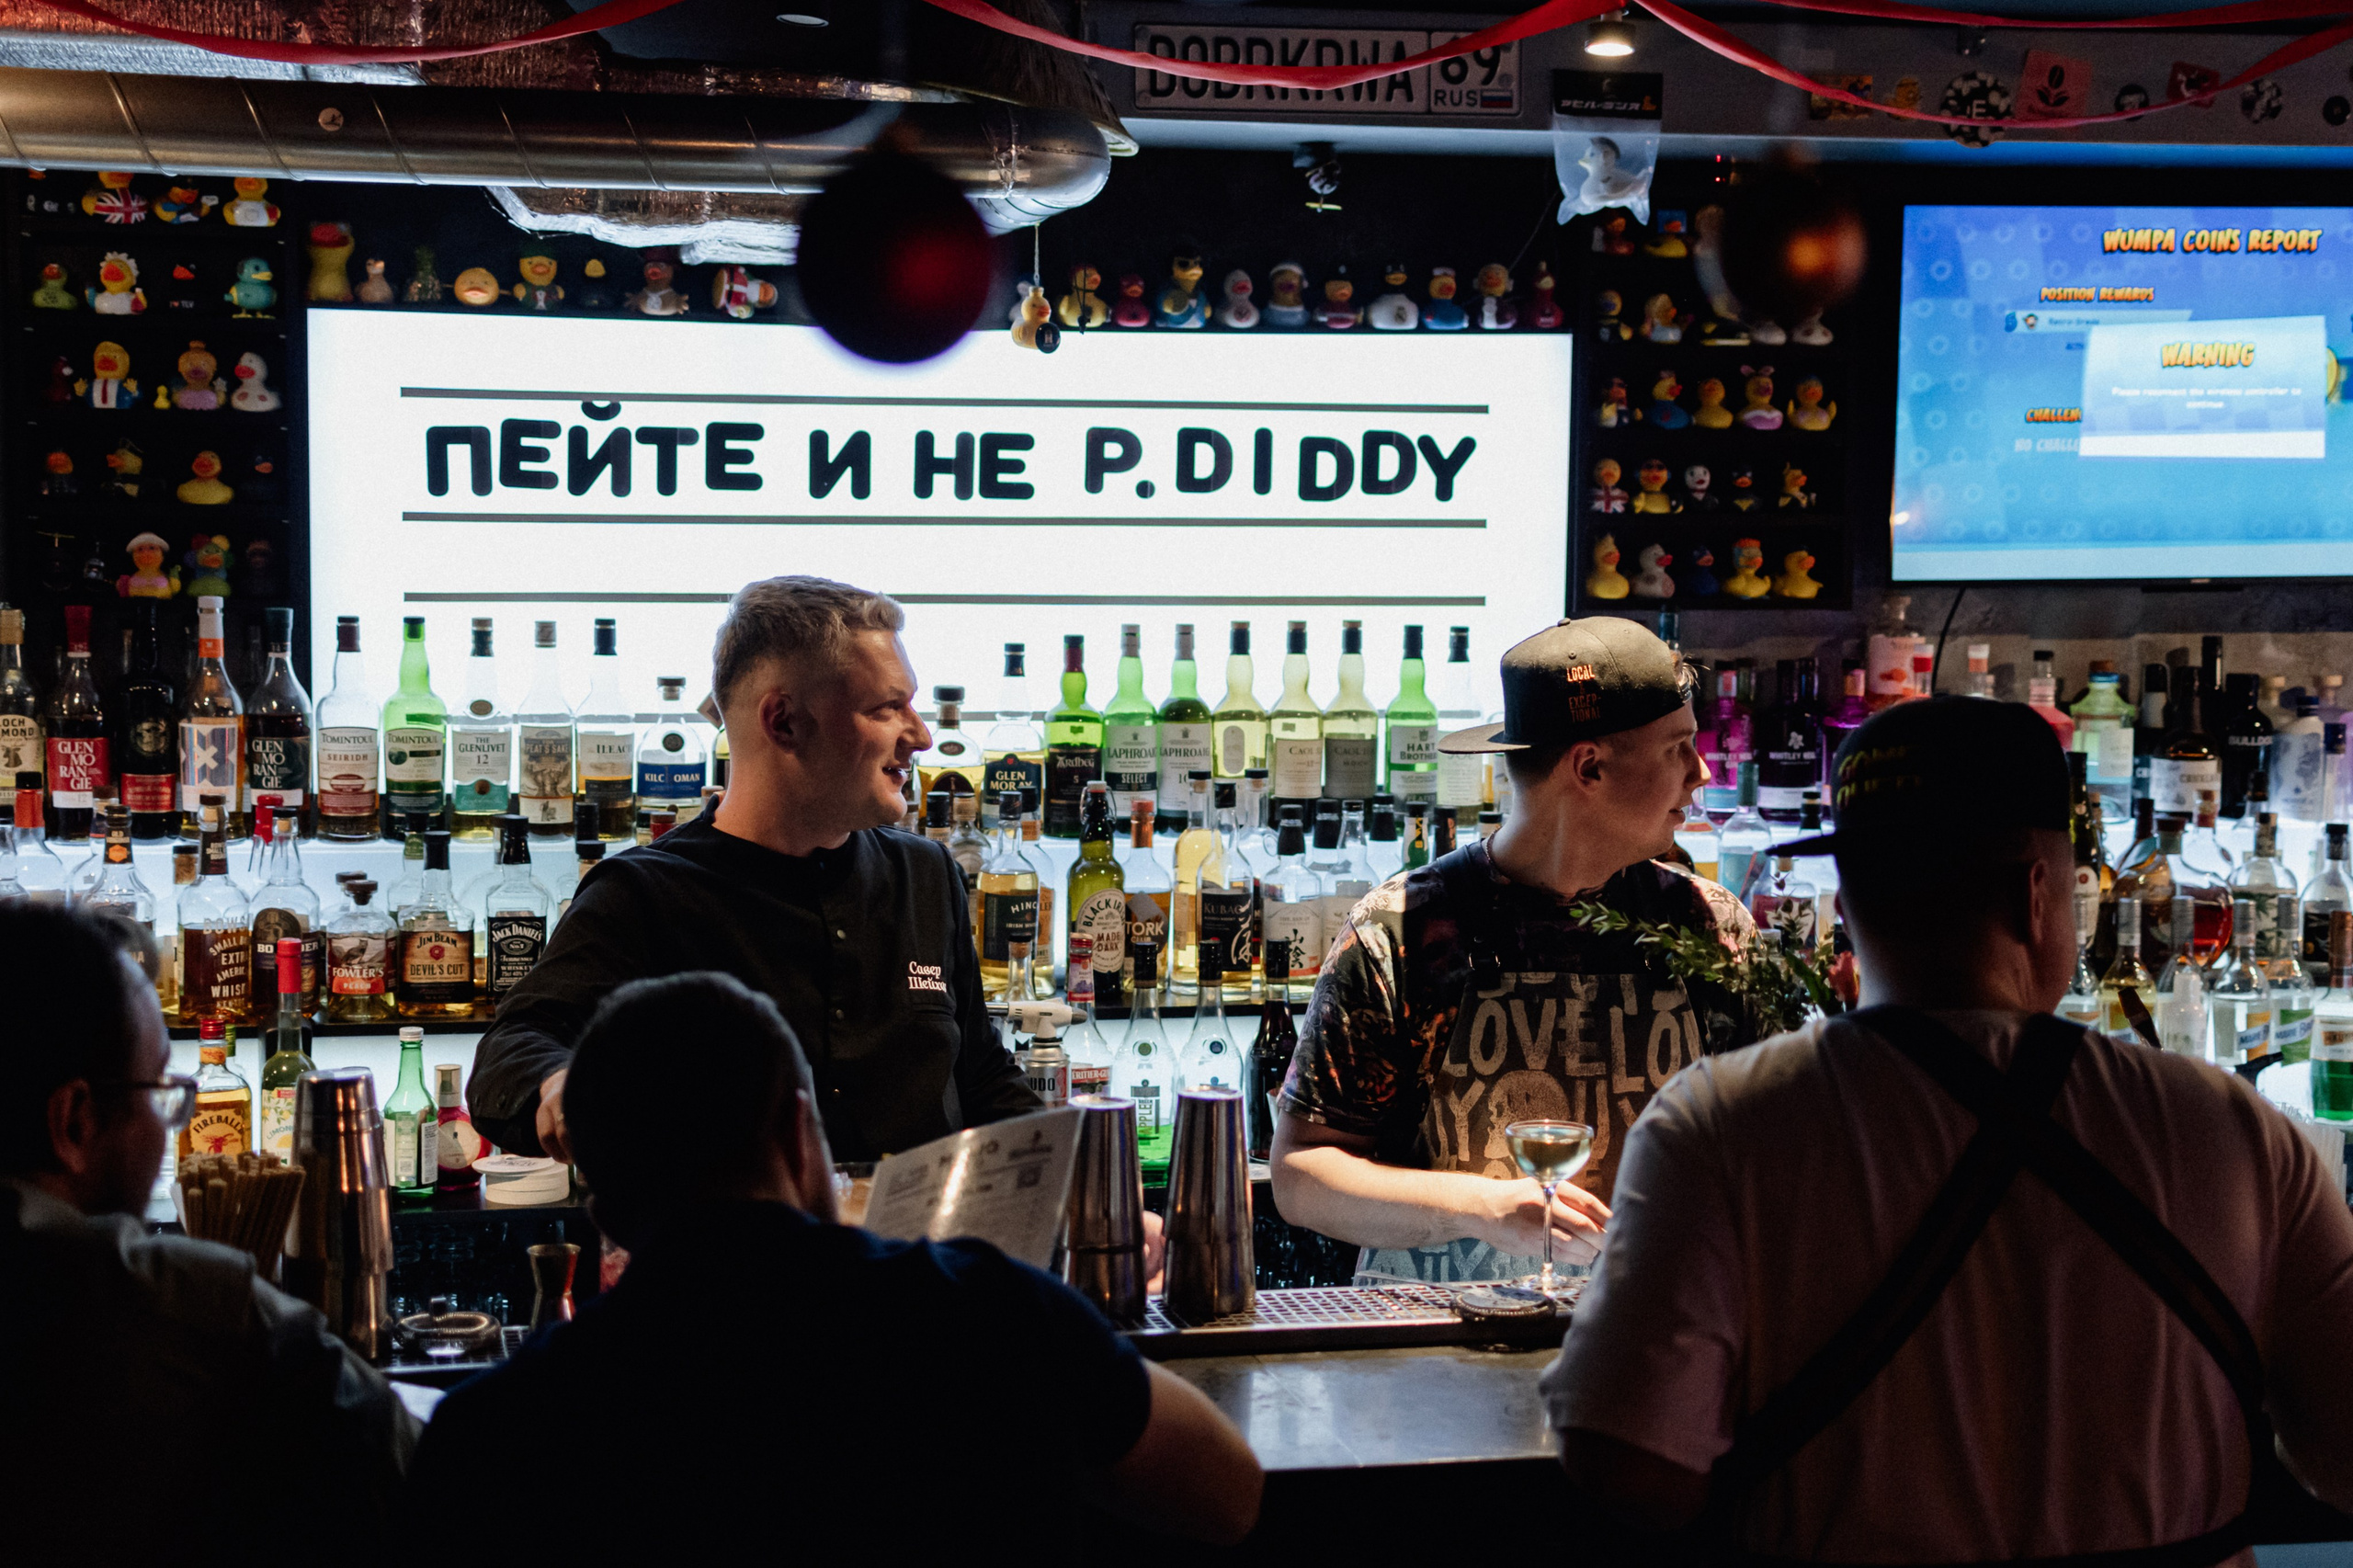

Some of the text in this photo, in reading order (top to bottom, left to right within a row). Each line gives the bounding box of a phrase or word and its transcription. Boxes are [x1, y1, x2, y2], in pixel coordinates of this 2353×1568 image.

[1434, 90, 1478, 108] RUS
[2102, 228, 2323, 254] WUMPA COINS REPORT
[2040, 287, 2154, 302] POSITION REWARDS
[2162, 342, 2255, 368] WARNING
[426, 400, 764, 497] ПЕЙТЕ
[810, 430, 870, 499] И
[915, 431, 1034, 500] НЕ
[1566, 664, 1596, 683] LOCAL
[0, 718, 26, 727] OCH
[322, 733, 372, 744] TOMINTOUL
[388, 733, 438, 744] TOMINTOUL
[57, 741, 95, 754] GLEN
[252, 739, 284, 753] GLEN
[459, 743, 506, 753] GLENLIVET
[1407, 743, 1436, 752] HART
[70, 754, 96, 766] MO
[261, 753, 285, 766] MO
[476, 754, 489, 765] 12
[59, 765, 87, 778] RAN
[253, 763, 277, 776] RAN
[995, 770, 1026, 780] GLEN
[70, 778, 93, 790] GIE
[262, 776, 282, 789] GIE
[644, 773, 700, 783] KILCOMAN
[1121, 773, 1148, 784] SELECT
[1083, 898, 1112, 926] BLACK
[492, 923, 543, 942] JACK DANIEL'S
[1097, 931, 1120, 942] MADE
[209, 937, 237, 956] SMALL
[416, 932, 458, 949] JIM BEAM
[1097, 942, 1120, 951] DARK
[332, 966, 384, 978] FOWLER'S
[410, 963, 464, 975] DEVIL'S CUT
[192, 1114, 244, 1135] FIREBALL
